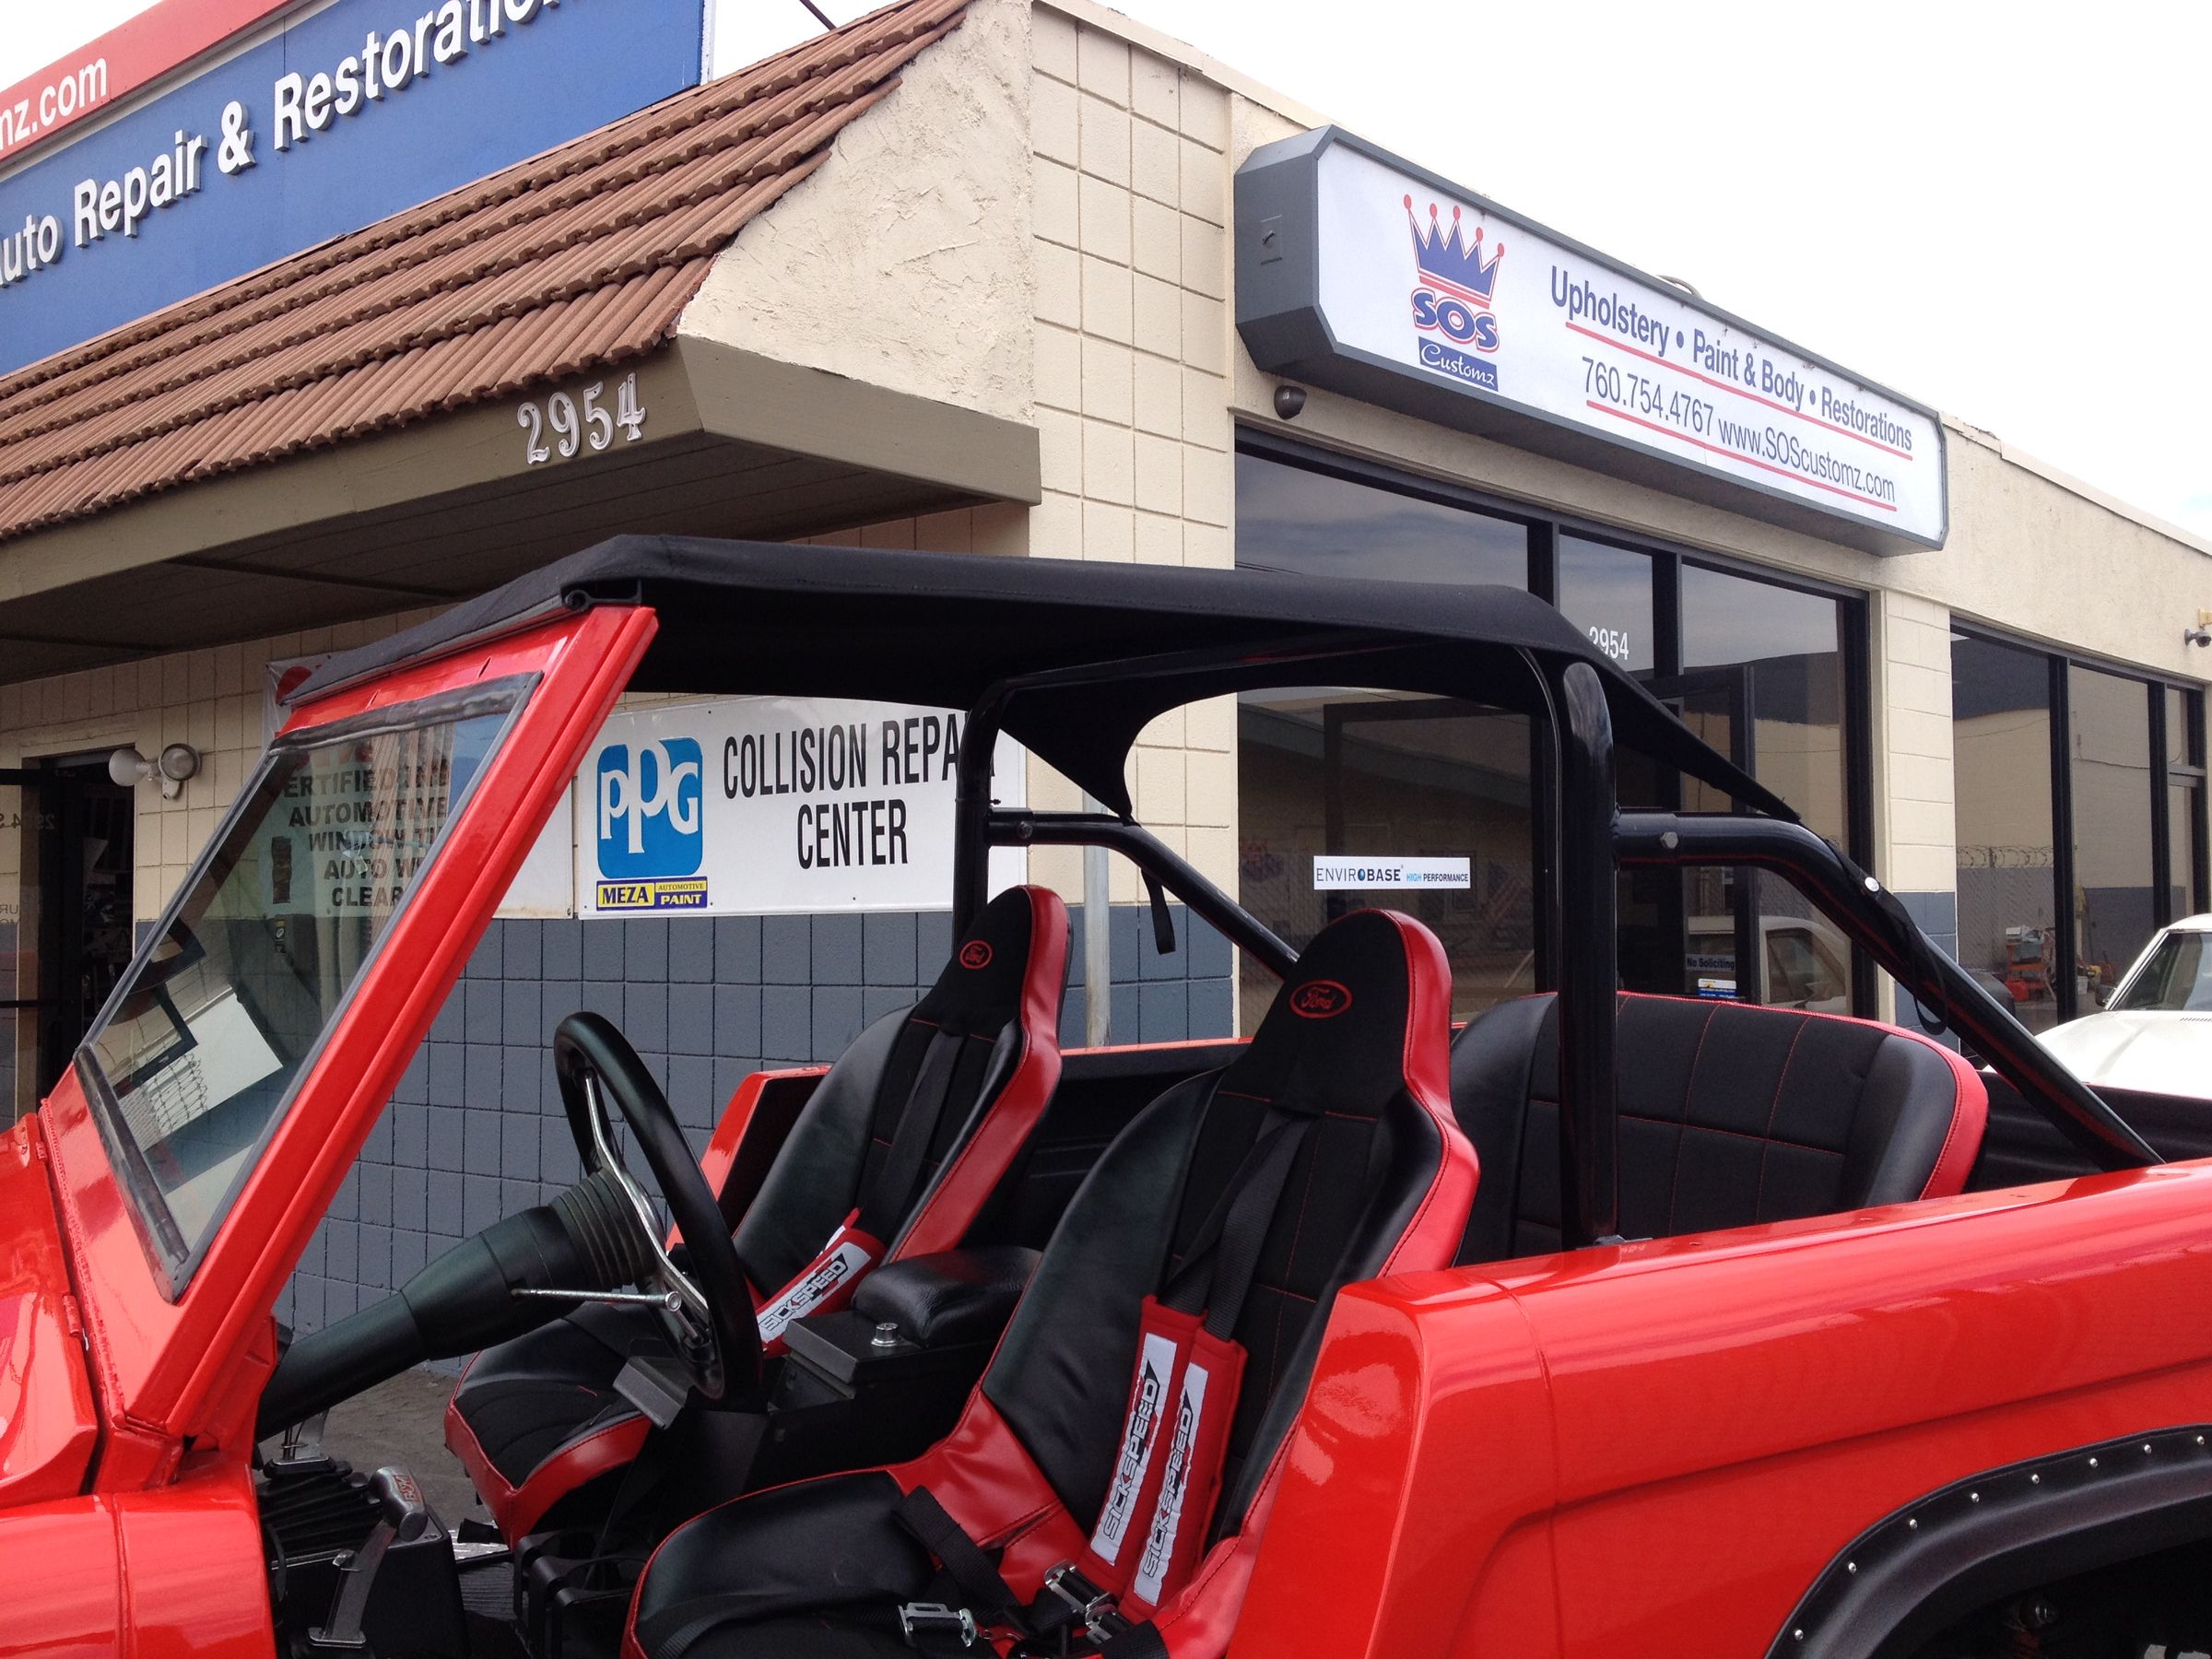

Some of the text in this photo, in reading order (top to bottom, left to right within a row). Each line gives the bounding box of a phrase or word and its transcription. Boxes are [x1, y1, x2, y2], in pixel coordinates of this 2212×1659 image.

[0, 213, 62, 287] uto
[75, 131, 207, 247] Repair
[218, 100, 256, 174] &
[1411, 288, 1500, 353] SOS
[1421, 344, 1495, 386] Customz
[1552, 265, 1912, 452] Upholstery Paint & Body Restorations
[517, 372, 647, 464] 2954
[1583, 357, 1896, 502] 760.754.4767 www.SOScustomz.com
[1590, 627, 1629, 660] 2954
[724, 713, 994, 799] COLLISION REPA
[288, 796, 448, 828] AUTOMOTIVE
[797, 799, 908, 869] CENTER
[602, 886, 649, 905] MEZA
[658, 882, 704, 891] AUTOMOTIVE
[1316, 867, 1401, 882] ENVIROBASE
[1423, 873, 1468, 882] PERFORMANCE
[661, 894, 701, 905] PAINT
[1687, 958, 1697, 968] No
